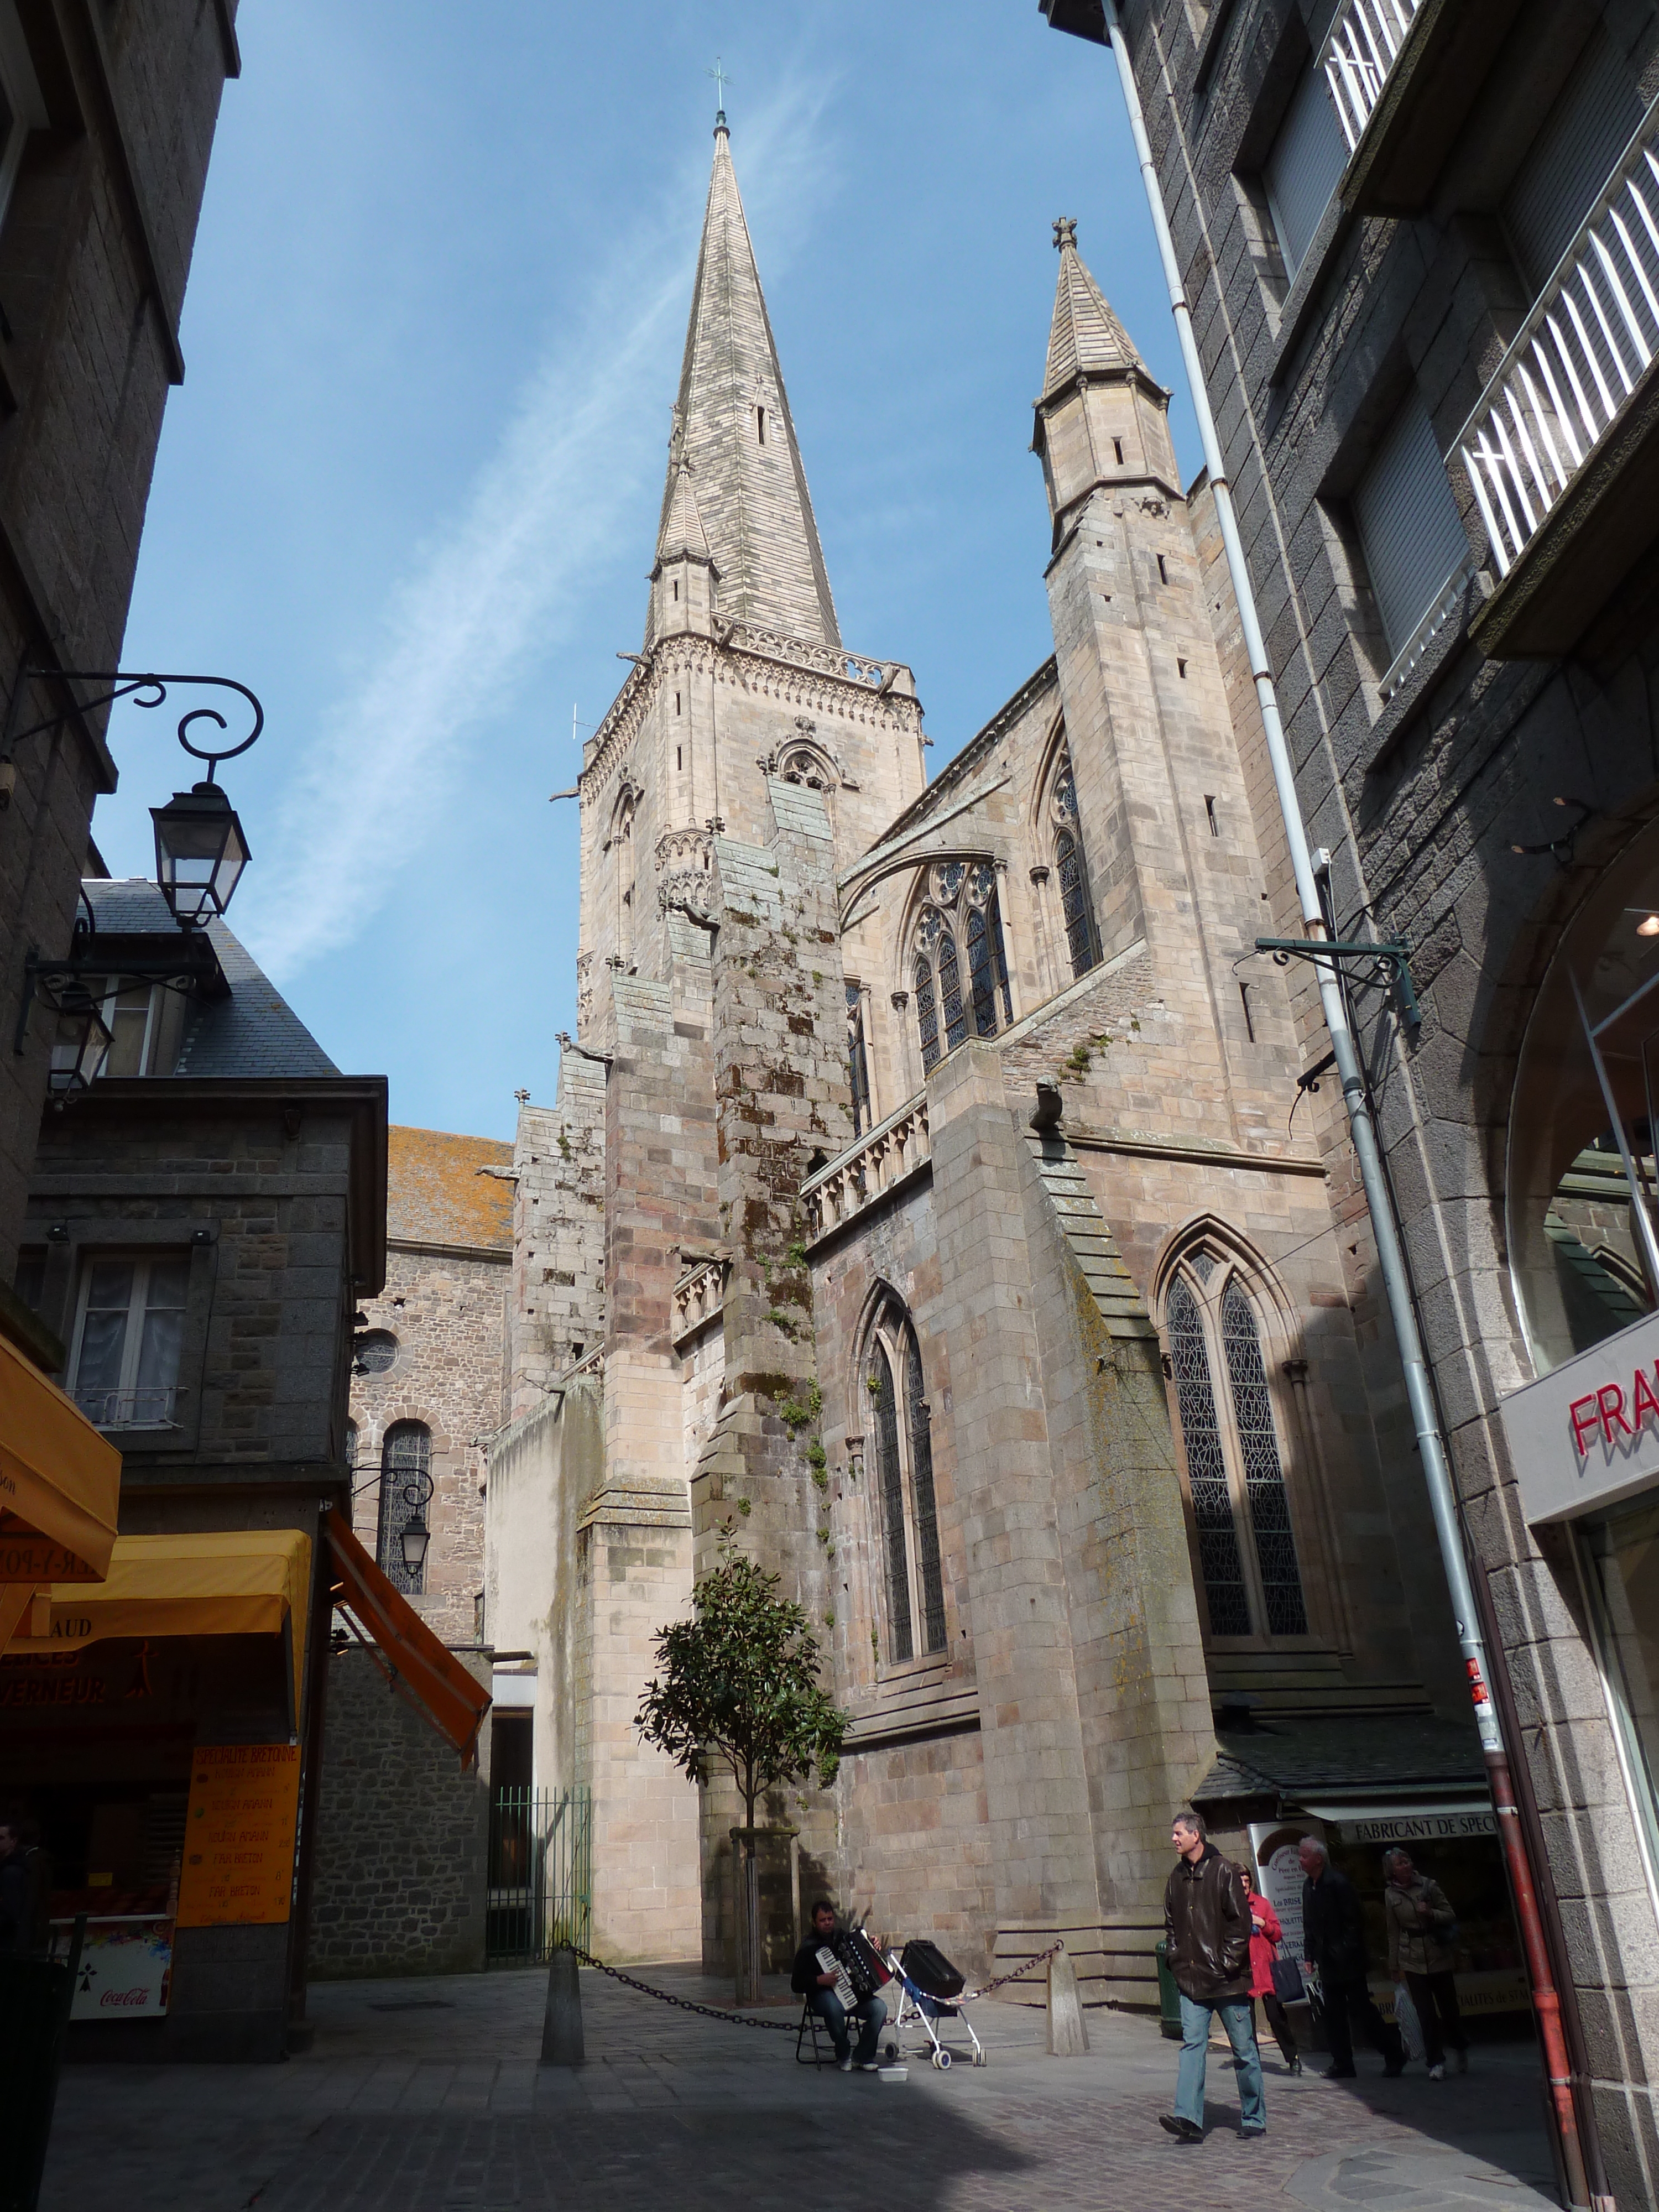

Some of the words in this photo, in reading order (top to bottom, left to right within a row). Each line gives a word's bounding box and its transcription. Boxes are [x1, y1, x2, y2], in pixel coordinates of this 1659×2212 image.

[251, 1745, 297, 1763] BRETONNE
[1355, 1820, 1432, 1840] FABRICANT
[1437, 1818, 1457, 1834] DE
[239, 1830, 269, 1843] AMANN
[213, 1853, 232, 1865] FAR
[234, 1853, 263, 1864] BRETON
[208, 1886, 226, 1898] FAR
[229, 1885, 261, 1897] BRETON
[100, 1987, 150, 2007] Coca-Cola
[1458, 1992, 1494, 2006] IALITES
